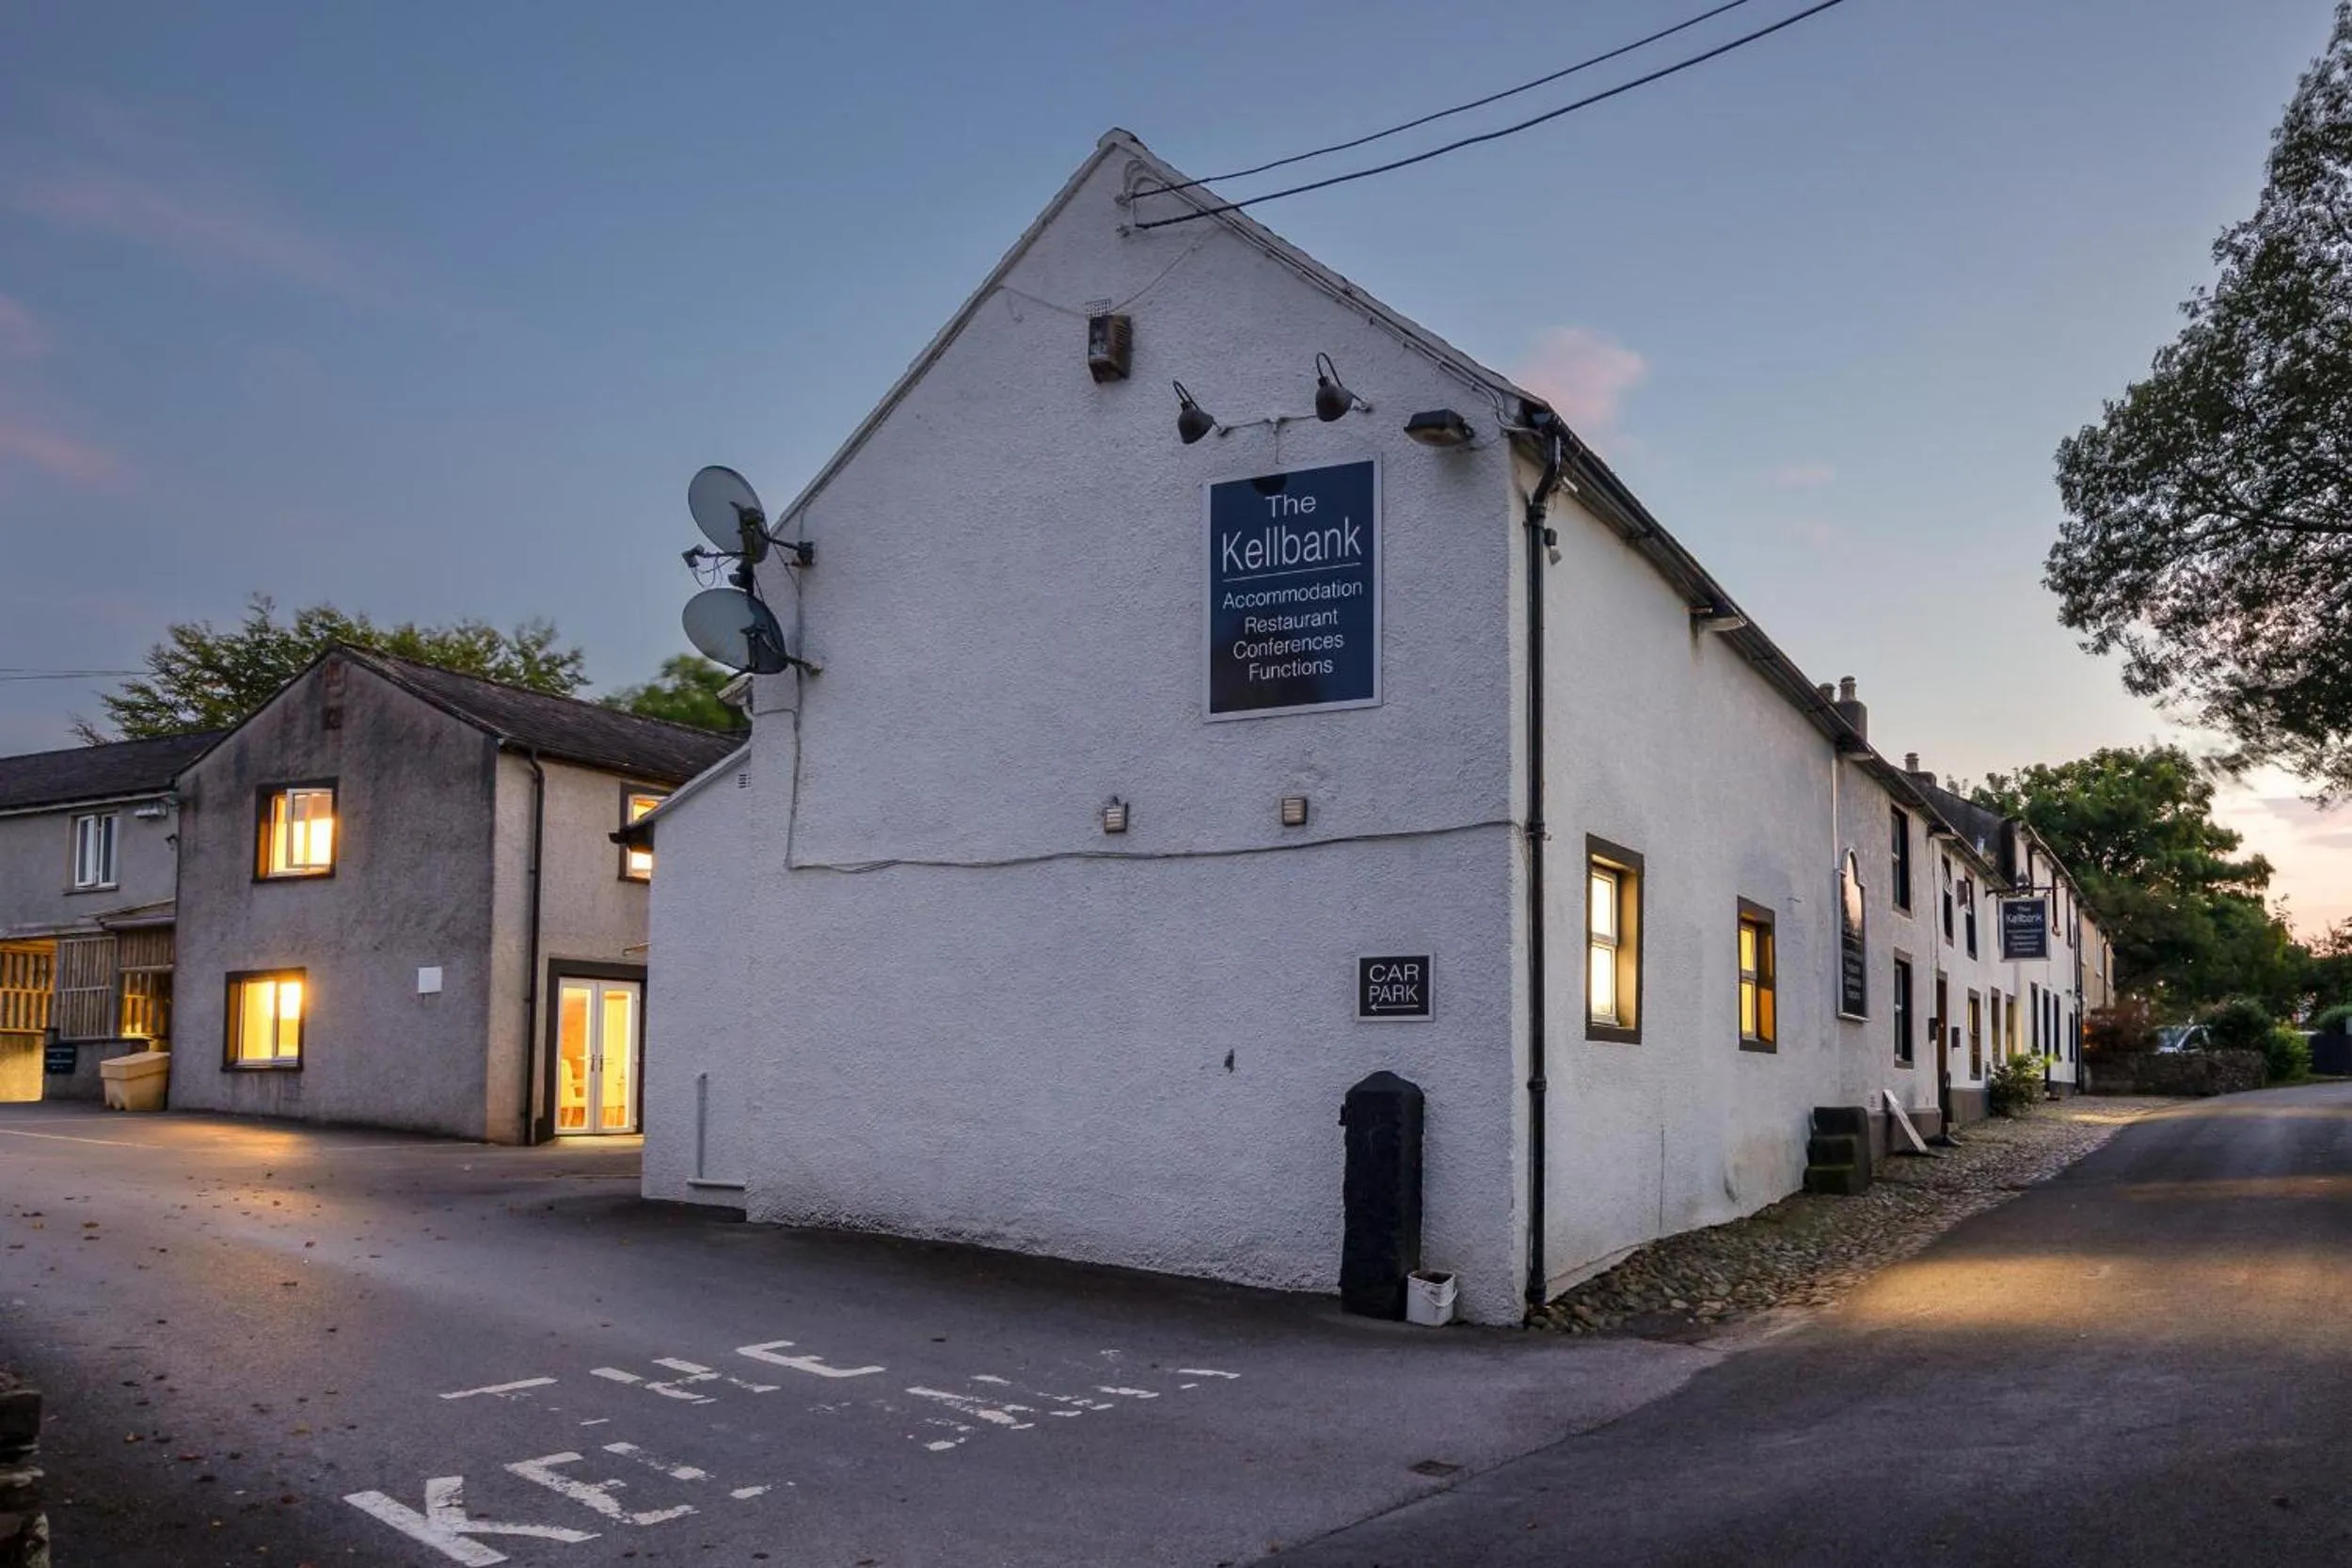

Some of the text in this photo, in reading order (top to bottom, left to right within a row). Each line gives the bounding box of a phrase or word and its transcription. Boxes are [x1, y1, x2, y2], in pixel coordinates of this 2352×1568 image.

[1264, 493, 1317, 518] The
[1222, 516, 1362, 573] Kellbank
[1222, 579, 1362, 610] Accommodation
[1244, 609, 1339, 635] Restaurant
[1232, 632, 1344, 659] Conferences
[1248, 657, 1334, 682] Functions
[1369, 963, 1420, 983] CAR
[1369, 984, 1419, 1003] PARK
